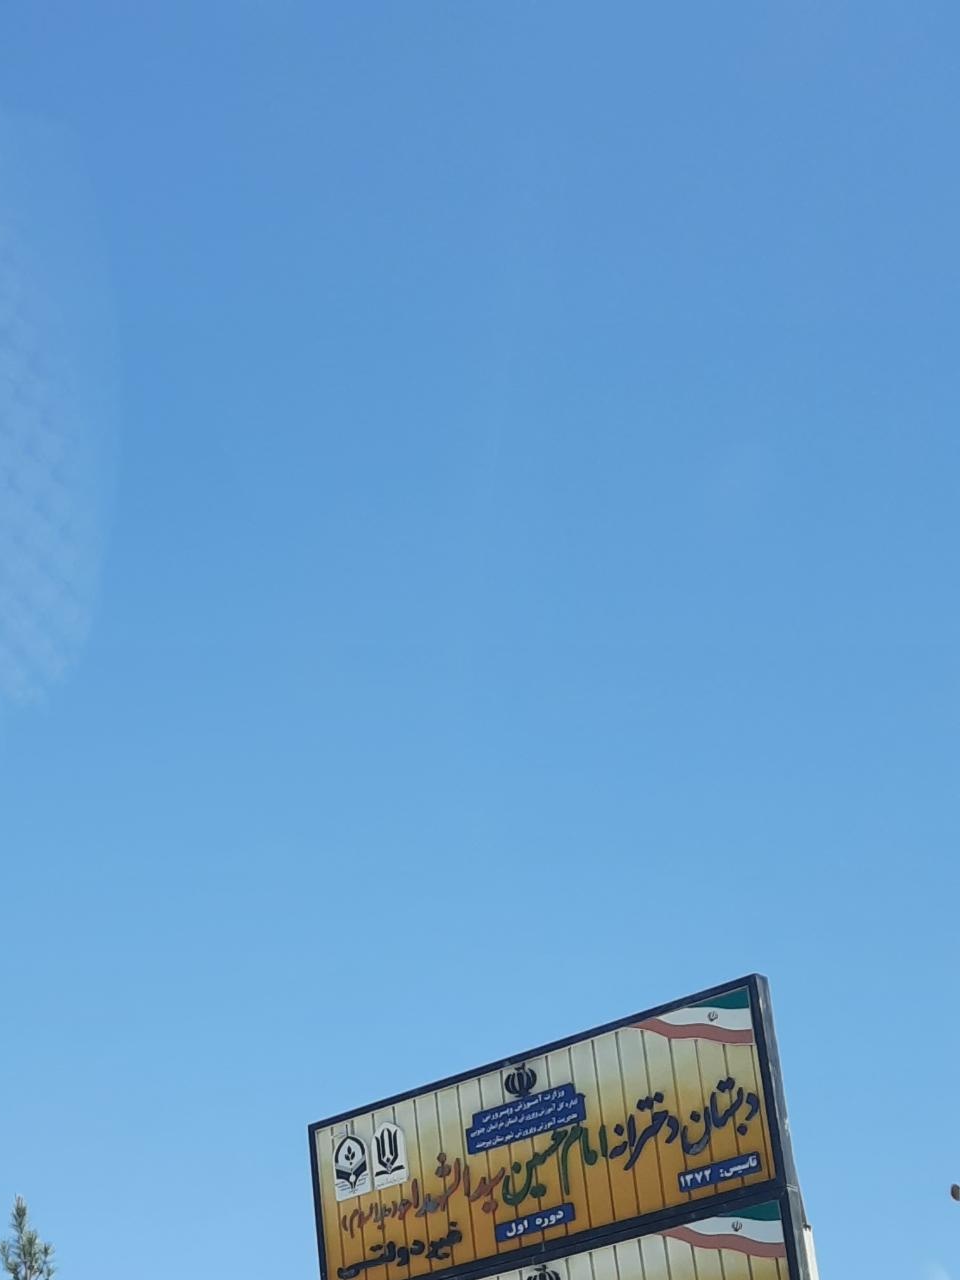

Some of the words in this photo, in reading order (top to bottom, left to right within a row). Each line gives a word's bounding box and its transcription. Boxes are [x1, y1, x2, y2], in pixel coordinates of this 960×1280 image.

[514, 1095, 542, 1112] آموزش
[543, 1089, 565, 1101] وزارت
[609, 1092, 680, 1171] دخترانه
[681, 1076, 760, 1156] دبستان
[502, 1129, 568, 1206] حسین
[561, 1124, 609, 1196] امام
[506, 1219, 529, 1238] اول
[535, 1209, 565, 1226] دوره
[337, 1240, 426, 1280] دولتی
